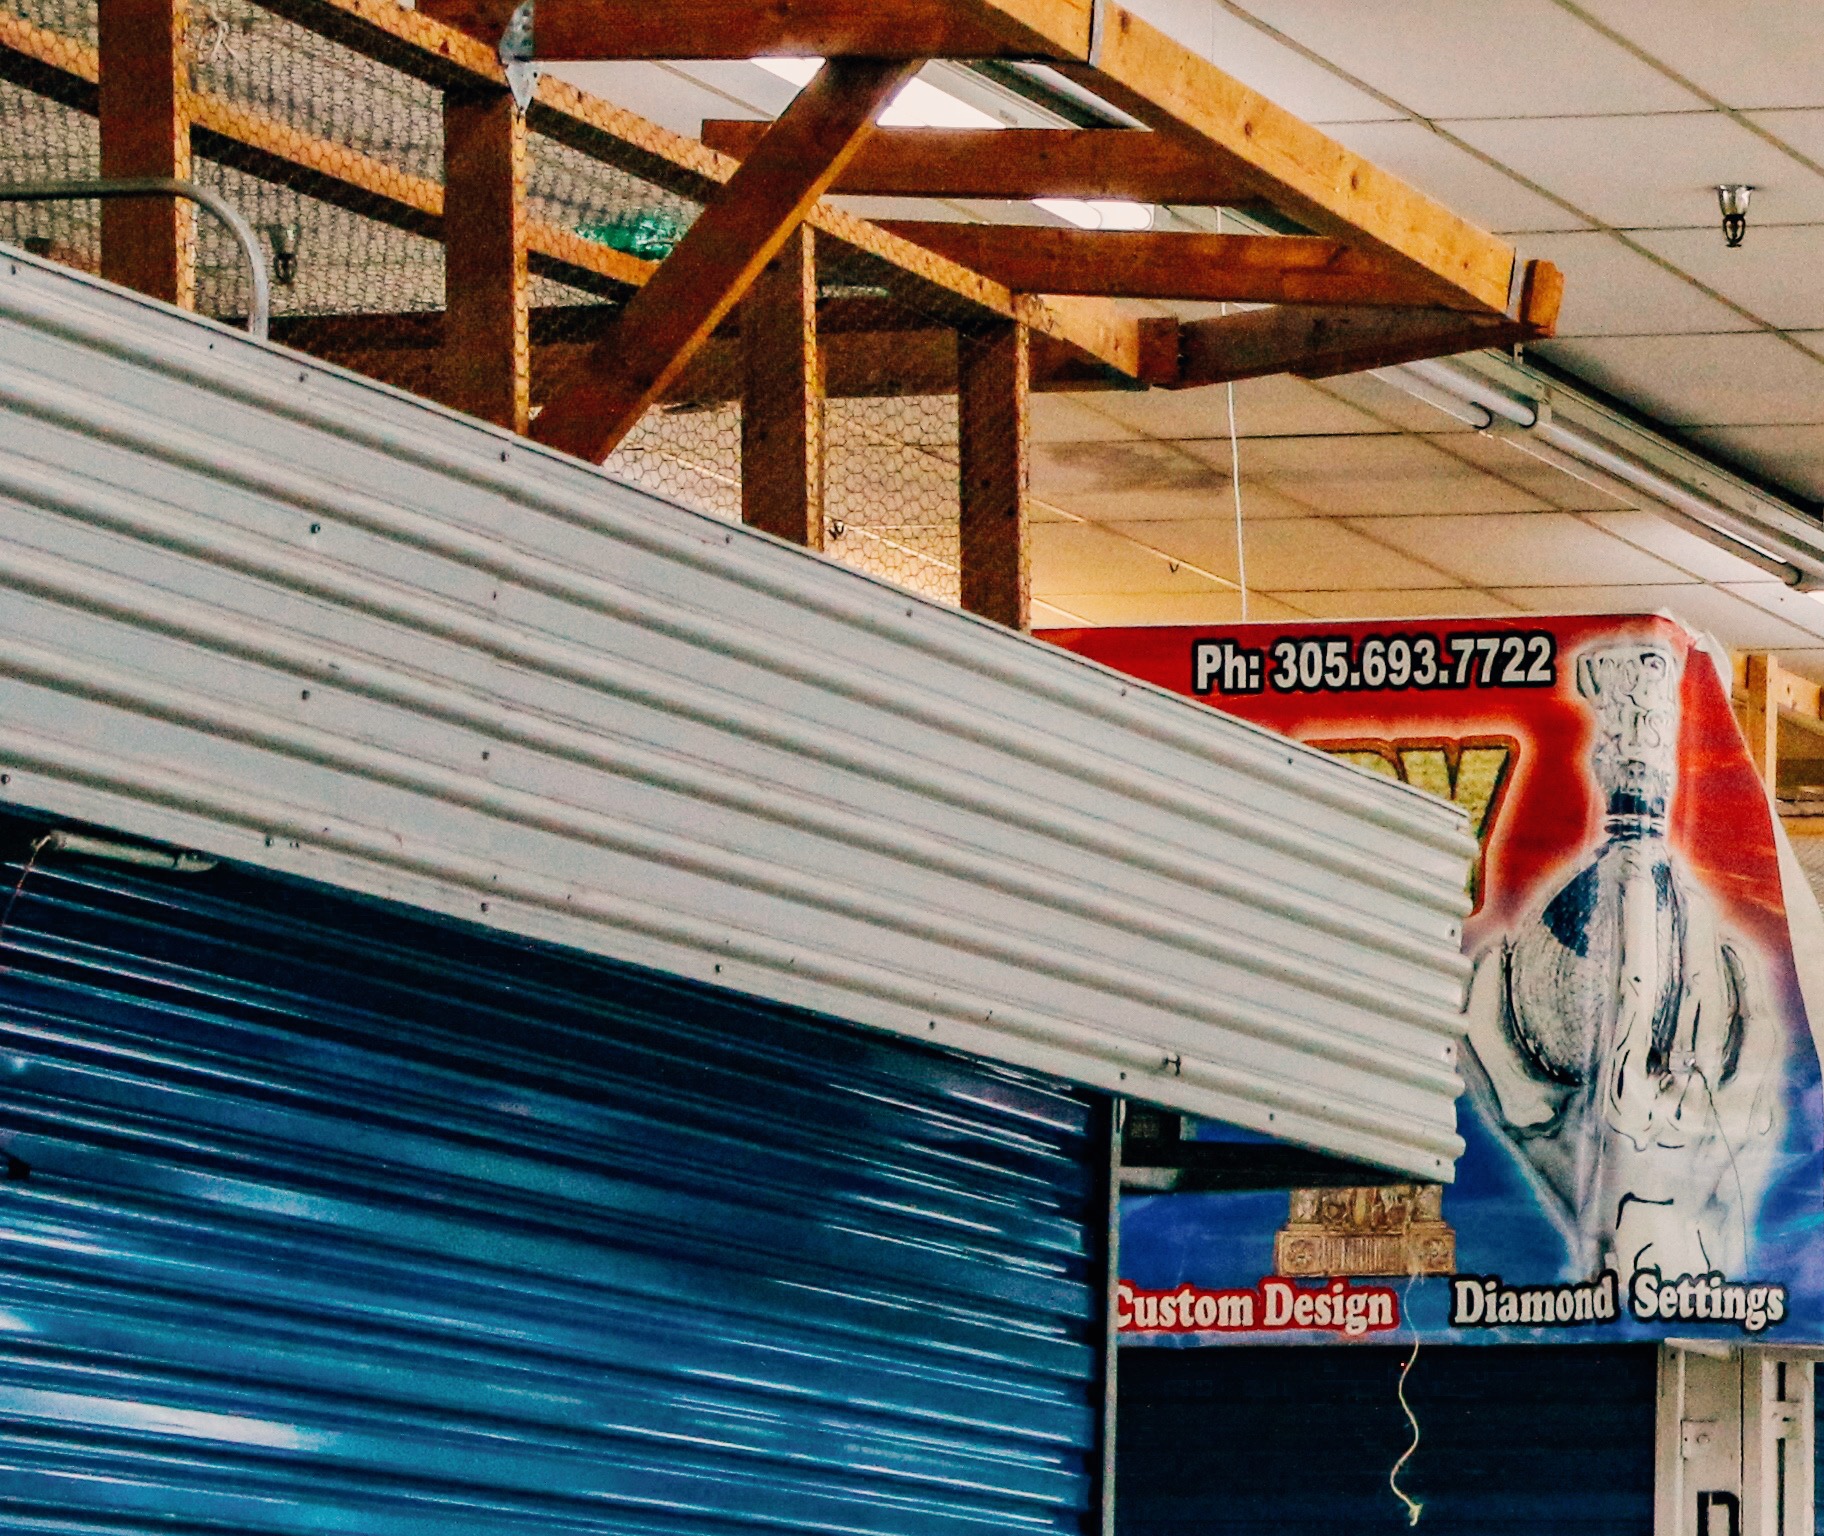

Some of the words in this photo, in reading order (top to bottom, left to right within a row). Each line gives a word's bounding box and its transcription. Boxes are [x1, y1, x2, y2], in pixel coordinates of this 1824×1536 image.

[1197, 643, 1260, 690] Ph:
[1273, 636, 1551, 688] 305.693.7722
[1116, 1283, 1254, 1328] Custom
[1263, 1282, 1394, 1335] Design
[1454, 1276, 1615, 1324] Diamond
[1633, 1273, 1785, 1331] Settings
